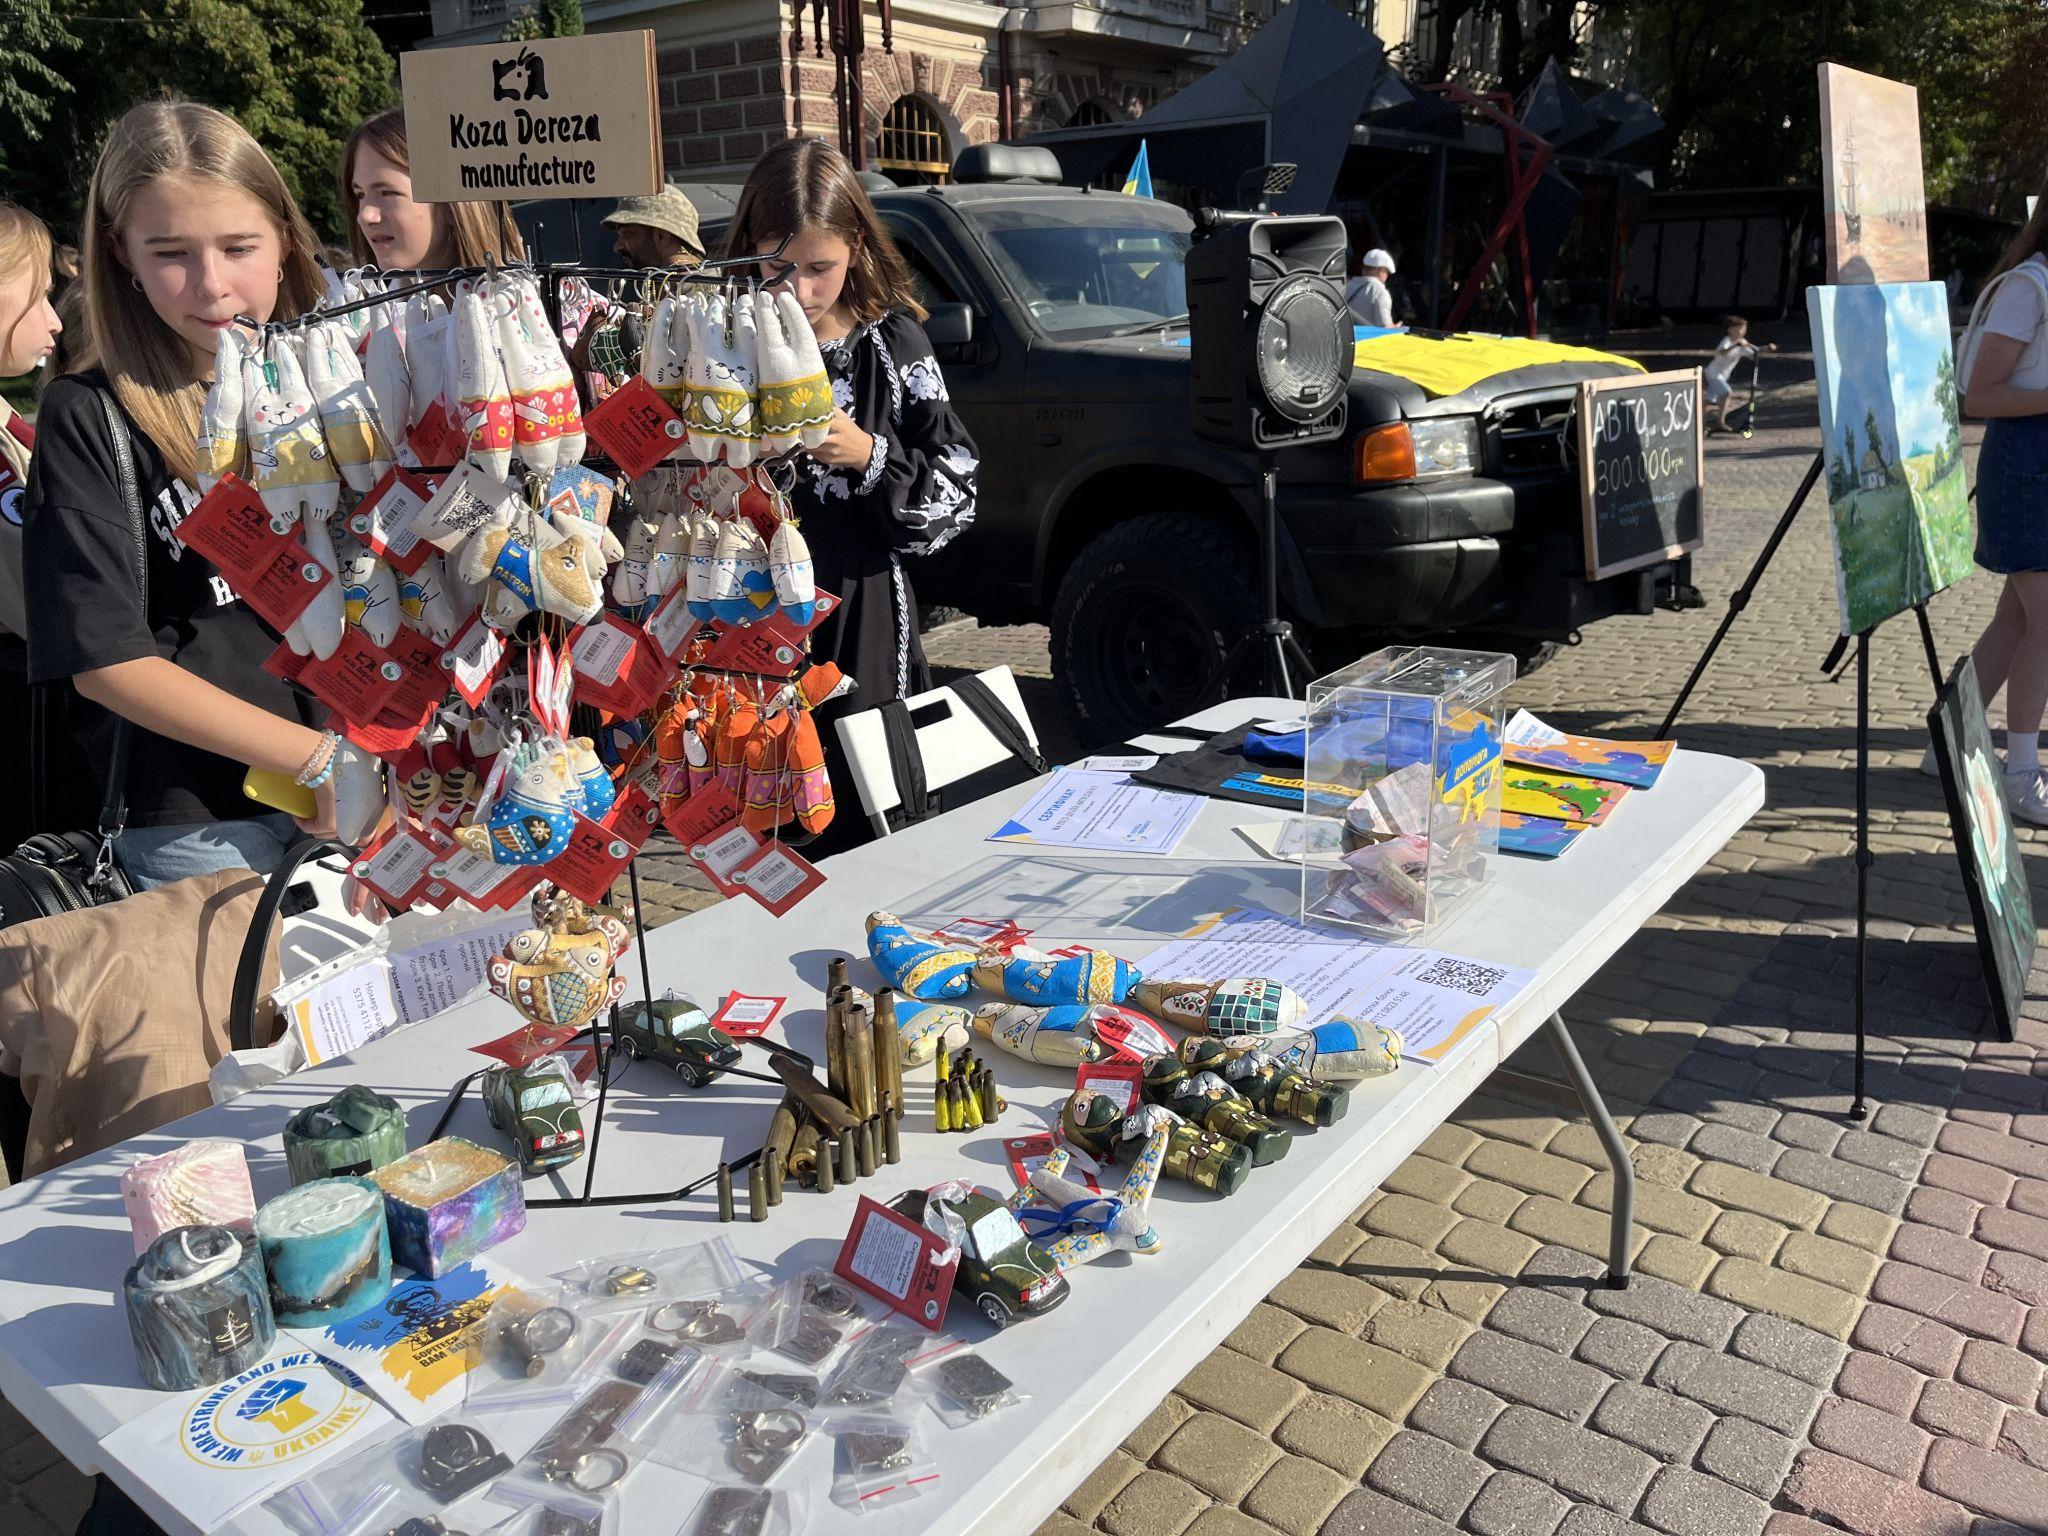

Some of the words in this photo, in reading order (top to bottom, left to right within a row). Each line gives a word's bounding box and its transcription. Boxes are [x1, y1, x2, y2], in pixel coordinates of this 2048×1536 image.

[450, 114, 509, 149] Koza
[513, 109, 601, 145] Dereza
[460, 152, 596, 188] manufacture
[1592, 397, 1648, 448] АВТО
[1661, 387, 1695, 438] ЗСУ
[1597, 454, 1634, 497] 300
[1638, 447, 1671, 484] 000
[352, 986, 366, 1009] 5375
[364, 980, 379, 1012] Номер
[281, 1353, 312, 1368] WE
[412, 1334, 460, 1362] БОРІТЕСЯ
[419, 1350, 448, 1368] ВАМ
[236, 1362, 276, 1386] AND
[190, 1384, 238, 1433] STRONG
[191, 1431, 222, 1454] ARE
[273, 1405, 363, 1459] UKRAINE
[211, 1444, 246, 1462] WE
